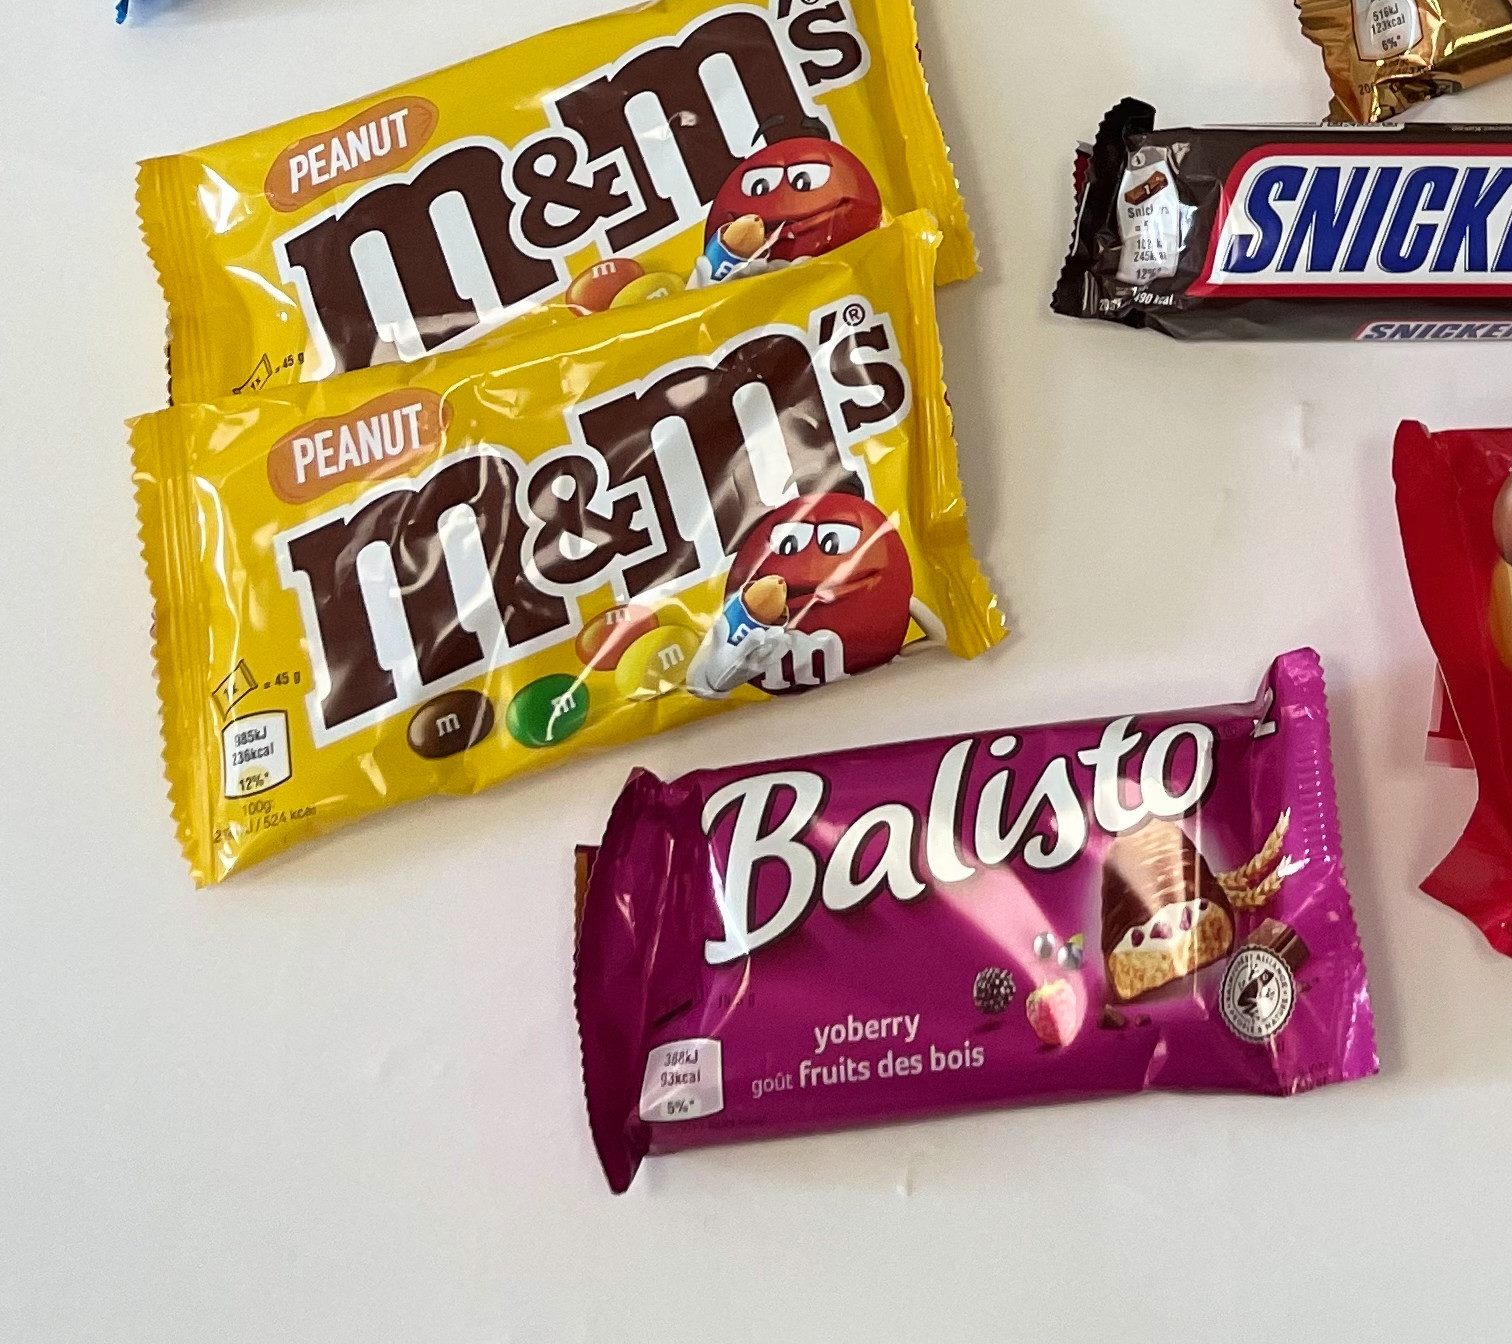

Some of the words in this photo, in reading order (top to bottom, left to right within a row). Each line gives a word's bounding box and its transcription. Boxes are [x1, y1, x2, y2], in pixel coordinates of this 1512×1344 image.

[1372, 14, 1406, 34] 123kcal
[288, 108, 410, 192] PEANUT
[1153, 294, 1174, 305] kcal
[292, 402, 424, 485] PEANUT
[287, 313, 906, 729] m&m's
[232, 742, 274, 766] 236kcal
[263, 813, 287, 829] 524
[290, 806, 317, 820] kcal
[701, 715, 1214, 965] Balisto
[814, 1012, 921, 1055] yoberry
[660, 1069, 701, 1088] 93kcal
[752, 1071, 793, 1099] goût
[800, 1057, 870, 1090] fruits
[879, 1052, 922, 1079] des
[930, 1040, 985, 1074] bois
